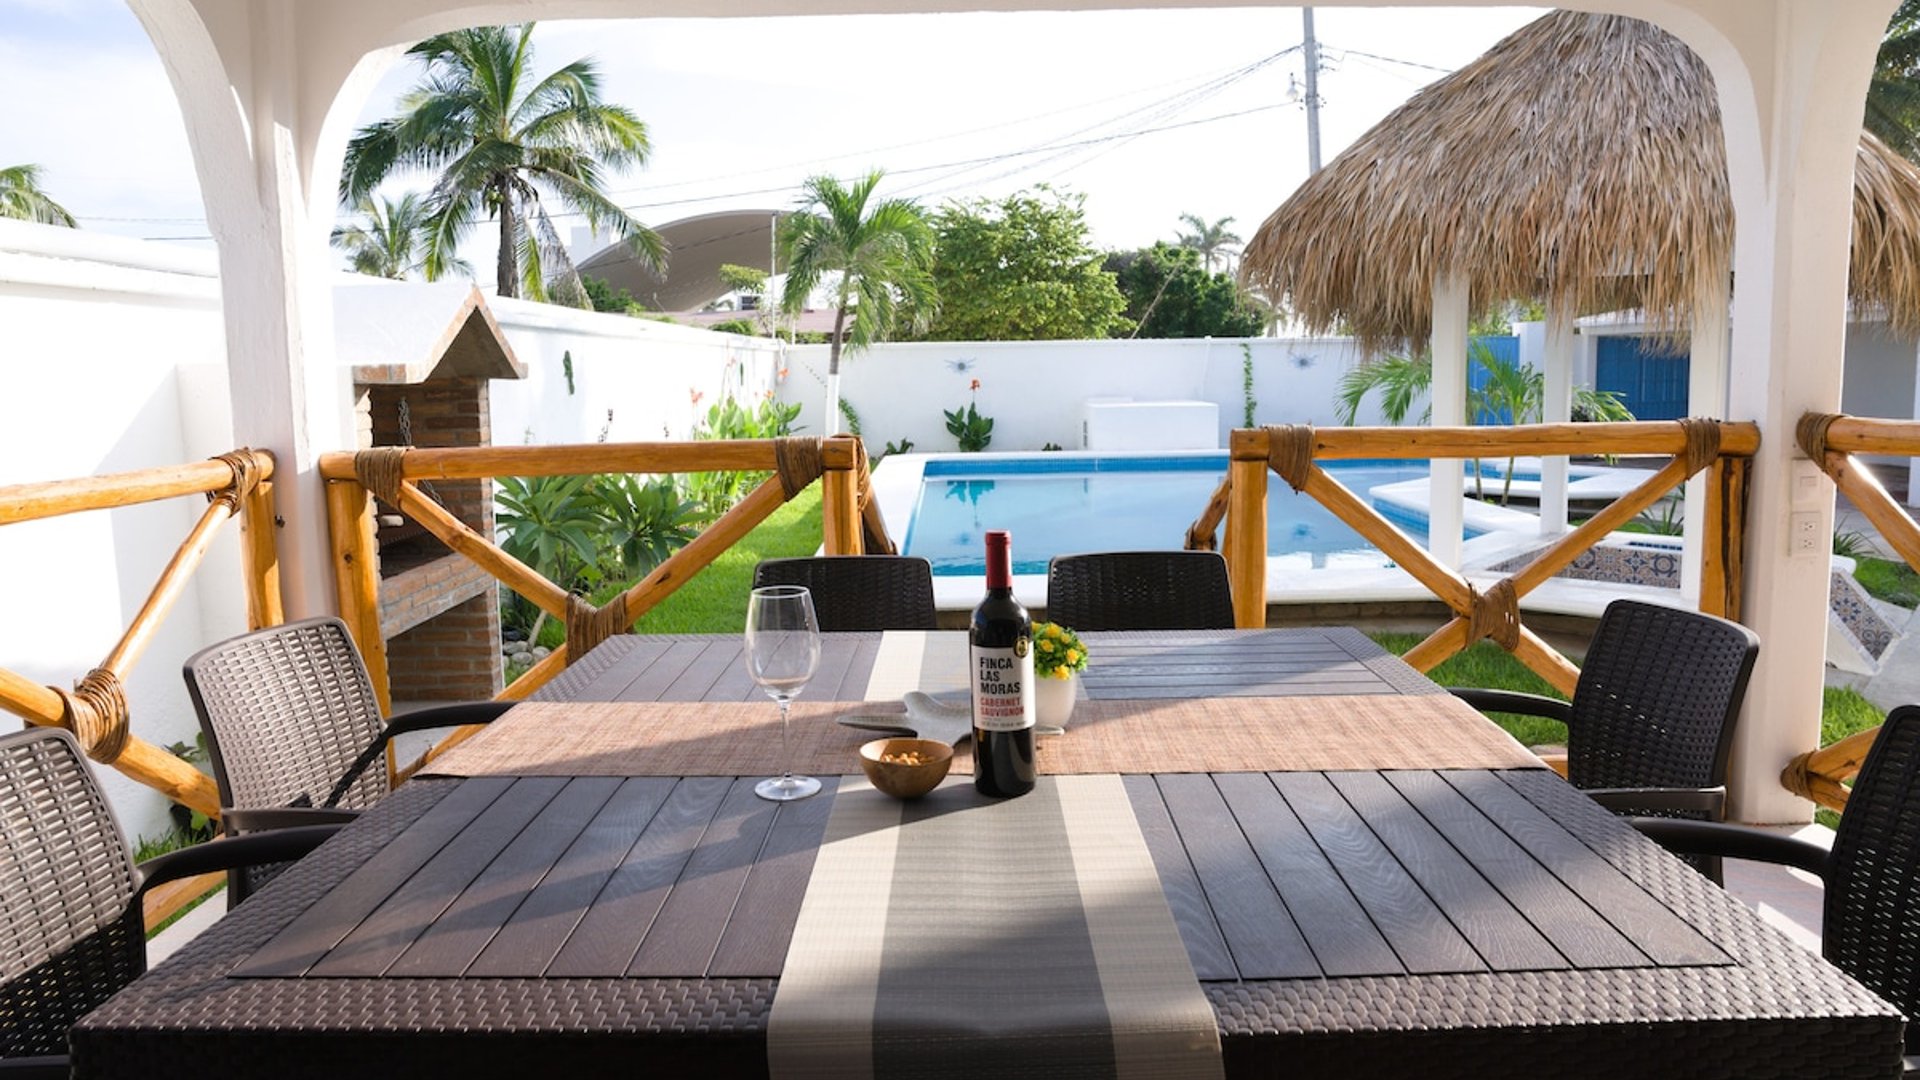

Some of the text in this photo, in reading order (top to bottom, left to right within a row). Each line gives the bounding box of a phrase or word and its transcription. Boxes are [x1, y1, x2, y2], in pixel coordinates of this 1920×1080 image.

[980, 656, 1013, 669] FINCA
[980, 669, 1000, 682] LAS
[980, 681, 1021, 695] MORAS
[980, 697, 1020, 707] CABERNET
[980, 705, 1025, 717] SAUVIGNON
